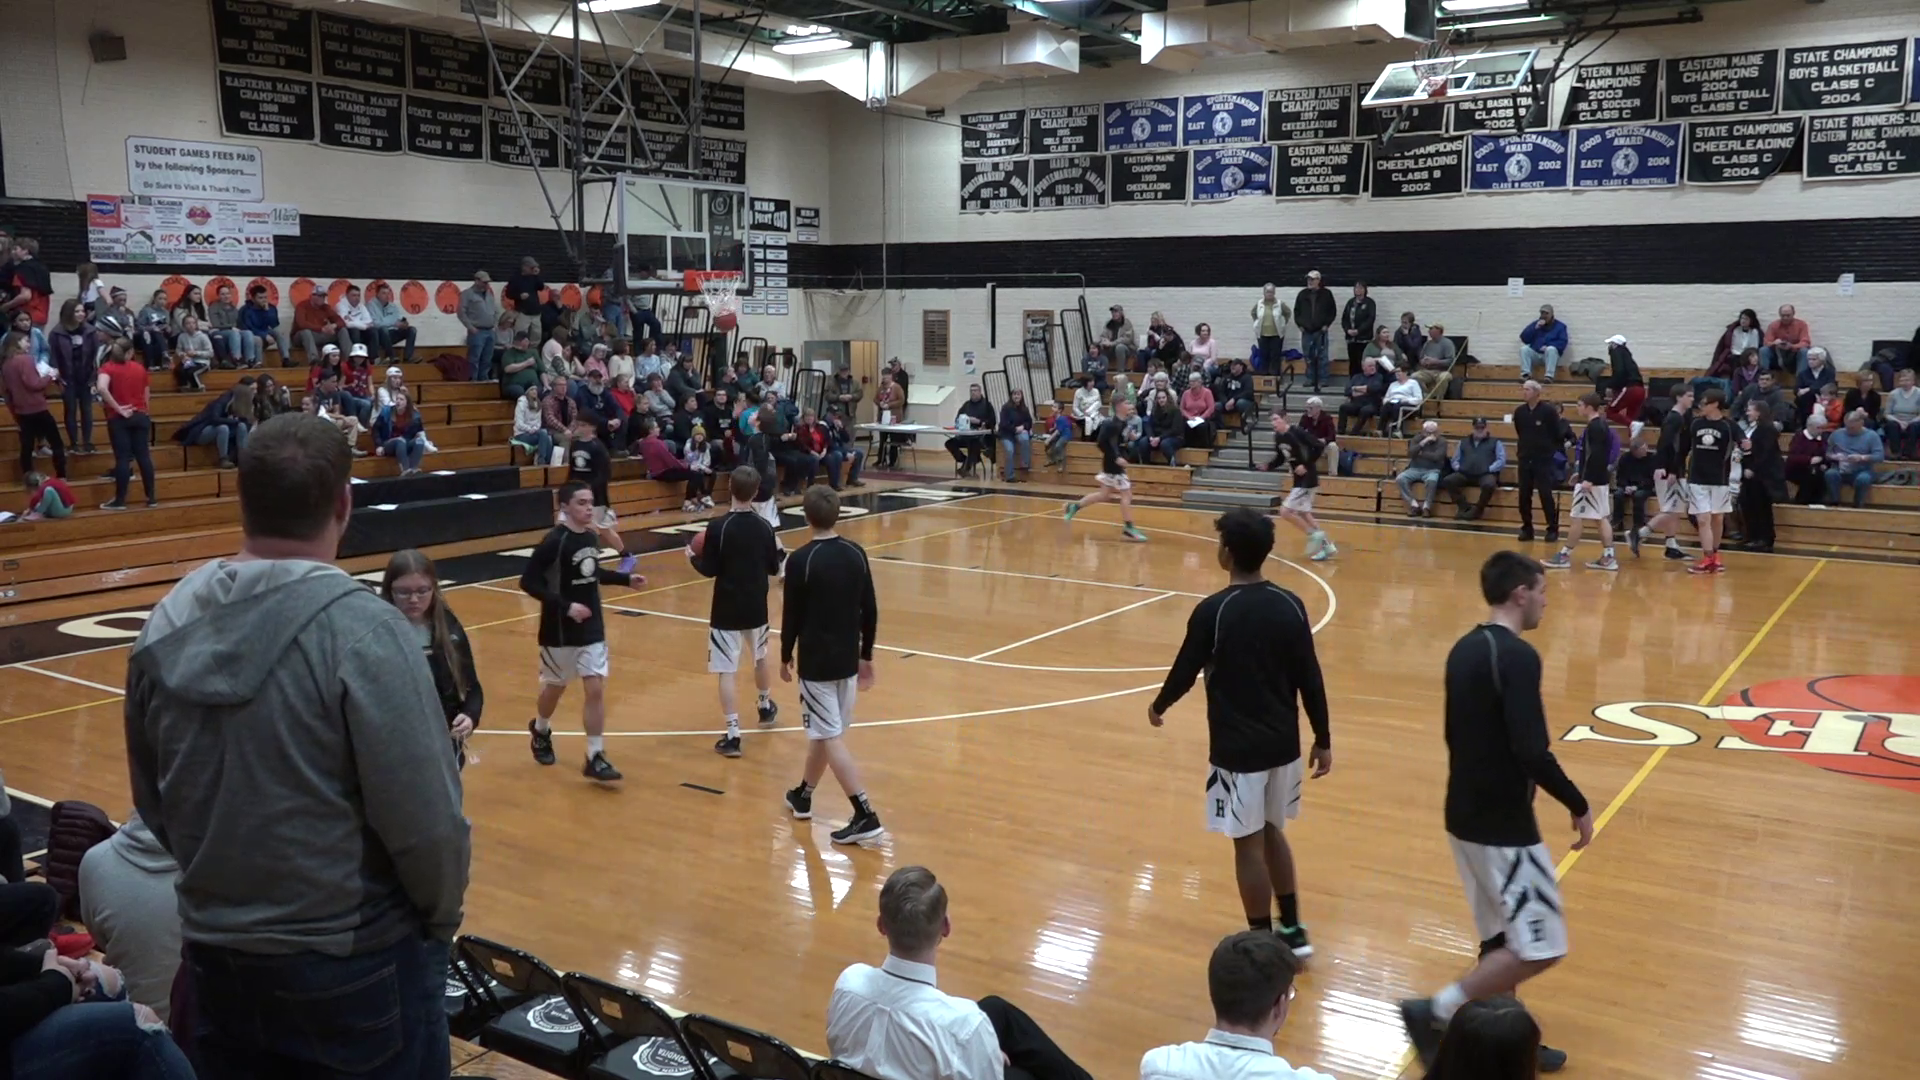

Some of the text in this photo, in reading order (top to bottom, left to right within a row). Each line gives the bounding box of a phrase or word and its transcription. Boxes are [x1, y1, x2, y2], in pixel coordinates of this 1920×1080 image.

[1793, 45, 1898, 64] STATE CHAMPIONS
[1616, 63, 1647, 75] MAINE
[1679, 54, 1764, 72] EASTERN MAINE
[1682, 66, 1759, 83] CHAMPIONS
[1789, 60, 1899, 80] BOYS BASKETBALL
[225, 76, 308, 94] EASTERN MAINE
[1701, 80, 1738, 91] 2004
[1811, 78, 1875, 92] CLASS C
[240, 90, 295, 104] CHAMPIONS
[321, 88, 399, 108] EASTERN MAINE
[1269, 86, 1351, 102] EASTERN MAINE
[1588, 90, 1623, 100] 2003
[1670, 88, 1770, 104] BOYS BASKETBALL
[1820, 92, 1862, 105] 2004
[334, 101, 387, 117] CHAMPIONS
[1206, 94, 1259, 113] SPORTSMANSHIP
[1212, 102, 1234, 111] AWARD
[1282, 99, 1340, 113] CHAMPIONS
[1459, 100, 1484, 110] GIRLS
[1602, 98, 1640, 109] SOCCER
[1690, 101, 1749, 113] CLASS C
[408, 106, 480, 124] STATE CHAMPIONS
[1030, 105, 1099, 119] EASTERN MAINE
[1475, 109, 1514, 120] CLASS
[1579, 110, 1631, 121] CLASS C
[248, 121, 280, 133] CLASS
[1040, 116, 1088, 129] CHAMPIONS
[1188, 122, 1205, 130] EAST
[1282, 120, 1337, 131] CHEERLEADING
[1484, 119, 1515, 129] 2002
[1813, 117, 1848, 130] STATE
[420, 124, 470, 137] BOYS GOLF
[1109, 127, 1125, 136] EAST
[1292, 130, 1314, 139] CLASS
[1695, 122, 1794, 138] STATE CHAMPIONS
[1810, 128, 1877, 143] EASTERN MAINE
[341, 133, 371, 146] CLASS
[1580, 134, 1602, 152] GOOD
[1605, 126, 1676, 148] SPORTSMANSHIP
[1613, 136, 1644, 146] AWARD
[416, 138, 442, 149] CLASS
[1505, 143, 1533, 153] AWARD
[1693, 137, 1795, 153] CHEERLEADING
[1847, 140, 1887, 152] 2004
[134, 145, 256, 162] STUDENT GAMES FEES PAID
[1288, 144, 1353, 156] EASTERN MAINE
[1474, 142, 1495, 159] GOOD
[1124, 154, 1175, 164] EASTERN MAINE
[1215, 150, 1269, 167] SPORTSMANSHIP
[1290, 155, 1348, 167] CHAMPIONS
[1376, 155, 1458, 170] CHEERLEADING
[1648, 156, 1670, 166] 2004
[1712, 153, 1772, 165] CLASS C
[1828, 150, 1906, 164] SOFTBALL
[135, 161, 204, 175] by the following
[1132, 164, 1167, 173] CHAMPIONS
[1476, 164, 1499, 172] EAST
[1538, 161, 1562, 170] 2002
[1581, 160, 1604, 169] EAST
[1834, 161, 1898, 174] CLASS C
[1306, 167, 1332, 175] 2001
[1392, 169, 1441, 181] CLASS B
[1722, 167, 1760, 177] 2004
[1198, 176, 1215, 184] EAST
[1290, 175, 1346, 185] CHEERLEADING
[1492, 181, 1512, 189] CLASS
[1632, 177, 1668, 185] BASKETBALL
[1126, 183, 1171, 191] CHEERLEADING
[1296, 186, 1329, 194] CLASS
[1401, 182, 1431, 192] 2002
[1134, 192, 1154, 200] CLASS
[160, 234, 182, 246] HPS
[185, 233, 216, 245] DOC
[1216, 798, 1224, 818] H
